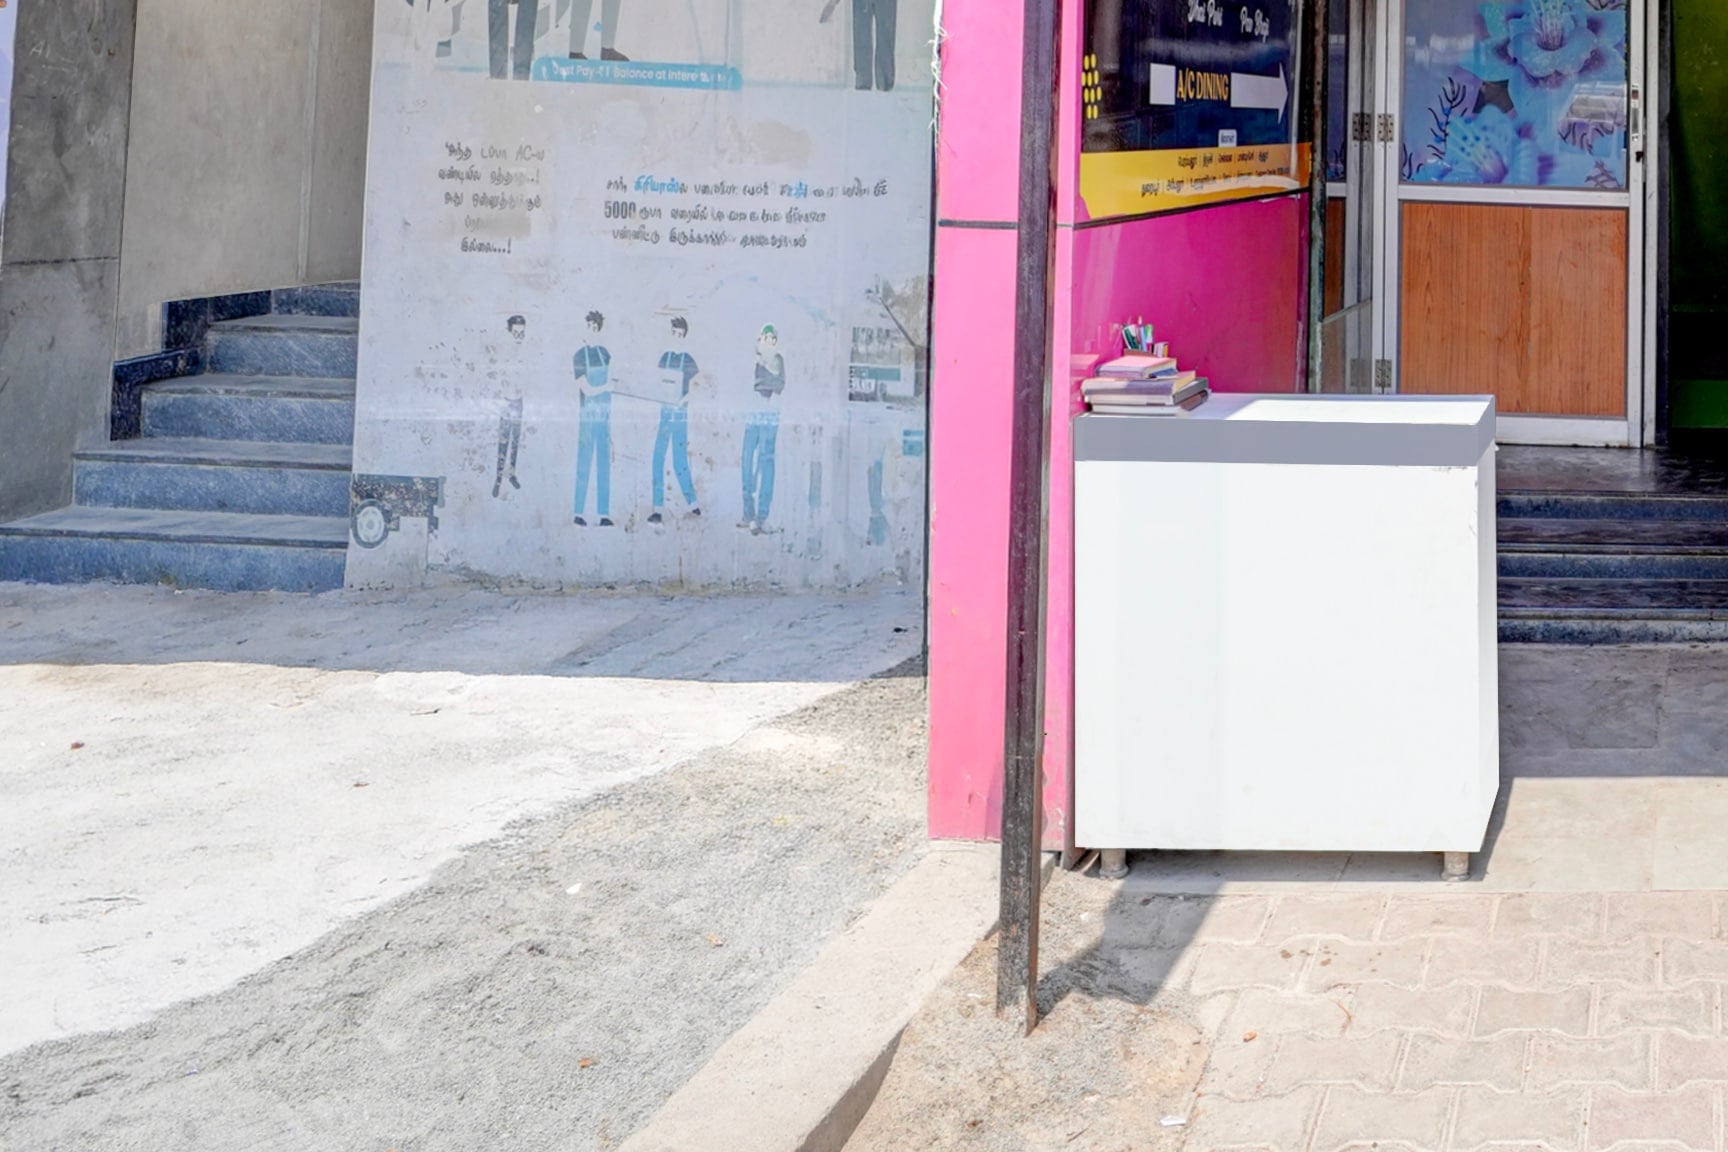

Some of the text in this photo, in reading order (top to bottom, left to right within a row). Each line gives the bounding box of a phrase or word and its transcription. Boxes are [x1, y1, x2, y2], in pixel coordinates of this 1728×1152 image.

[613, 66, 654, 81] Balance
[1177, 67, 1229, 102] A/C DINING
